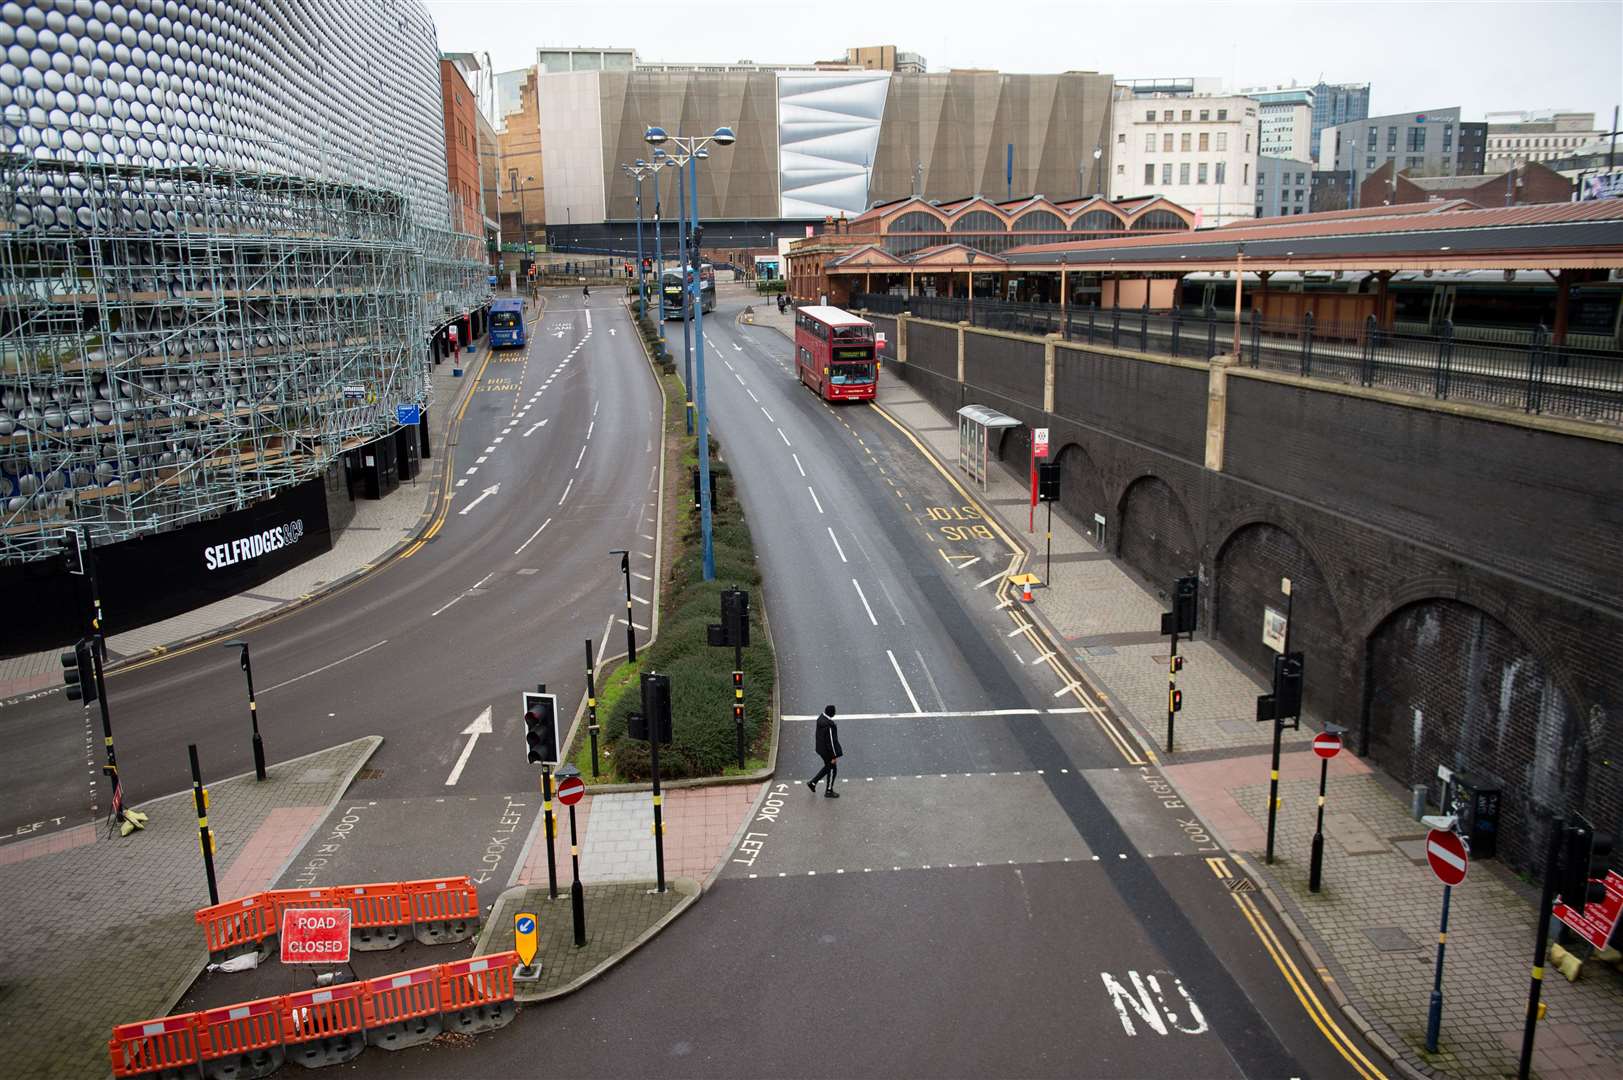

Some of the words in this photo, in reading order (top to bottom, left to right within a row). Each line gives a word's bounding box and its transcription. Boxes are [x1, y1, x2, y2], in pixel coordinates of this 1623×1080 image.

[940, 525, 995, 541] BUS
[756, 792, 789, 822] LOOK
[1142, 775, 1185, 809] RIGHT
[328, 806, 368, 840] LOOK
[477, 837, 510, 871] LOOK
[497, 801, 526, 832] LEFT
[1176, 819, 1220, 851] LOOK
[296, 843, 340, 885] RIGHT
[733, 832, 768, 866] LEFT
[298, 917, 336, 929] ROAD
[289, 941, 343, 953] CLOSED
